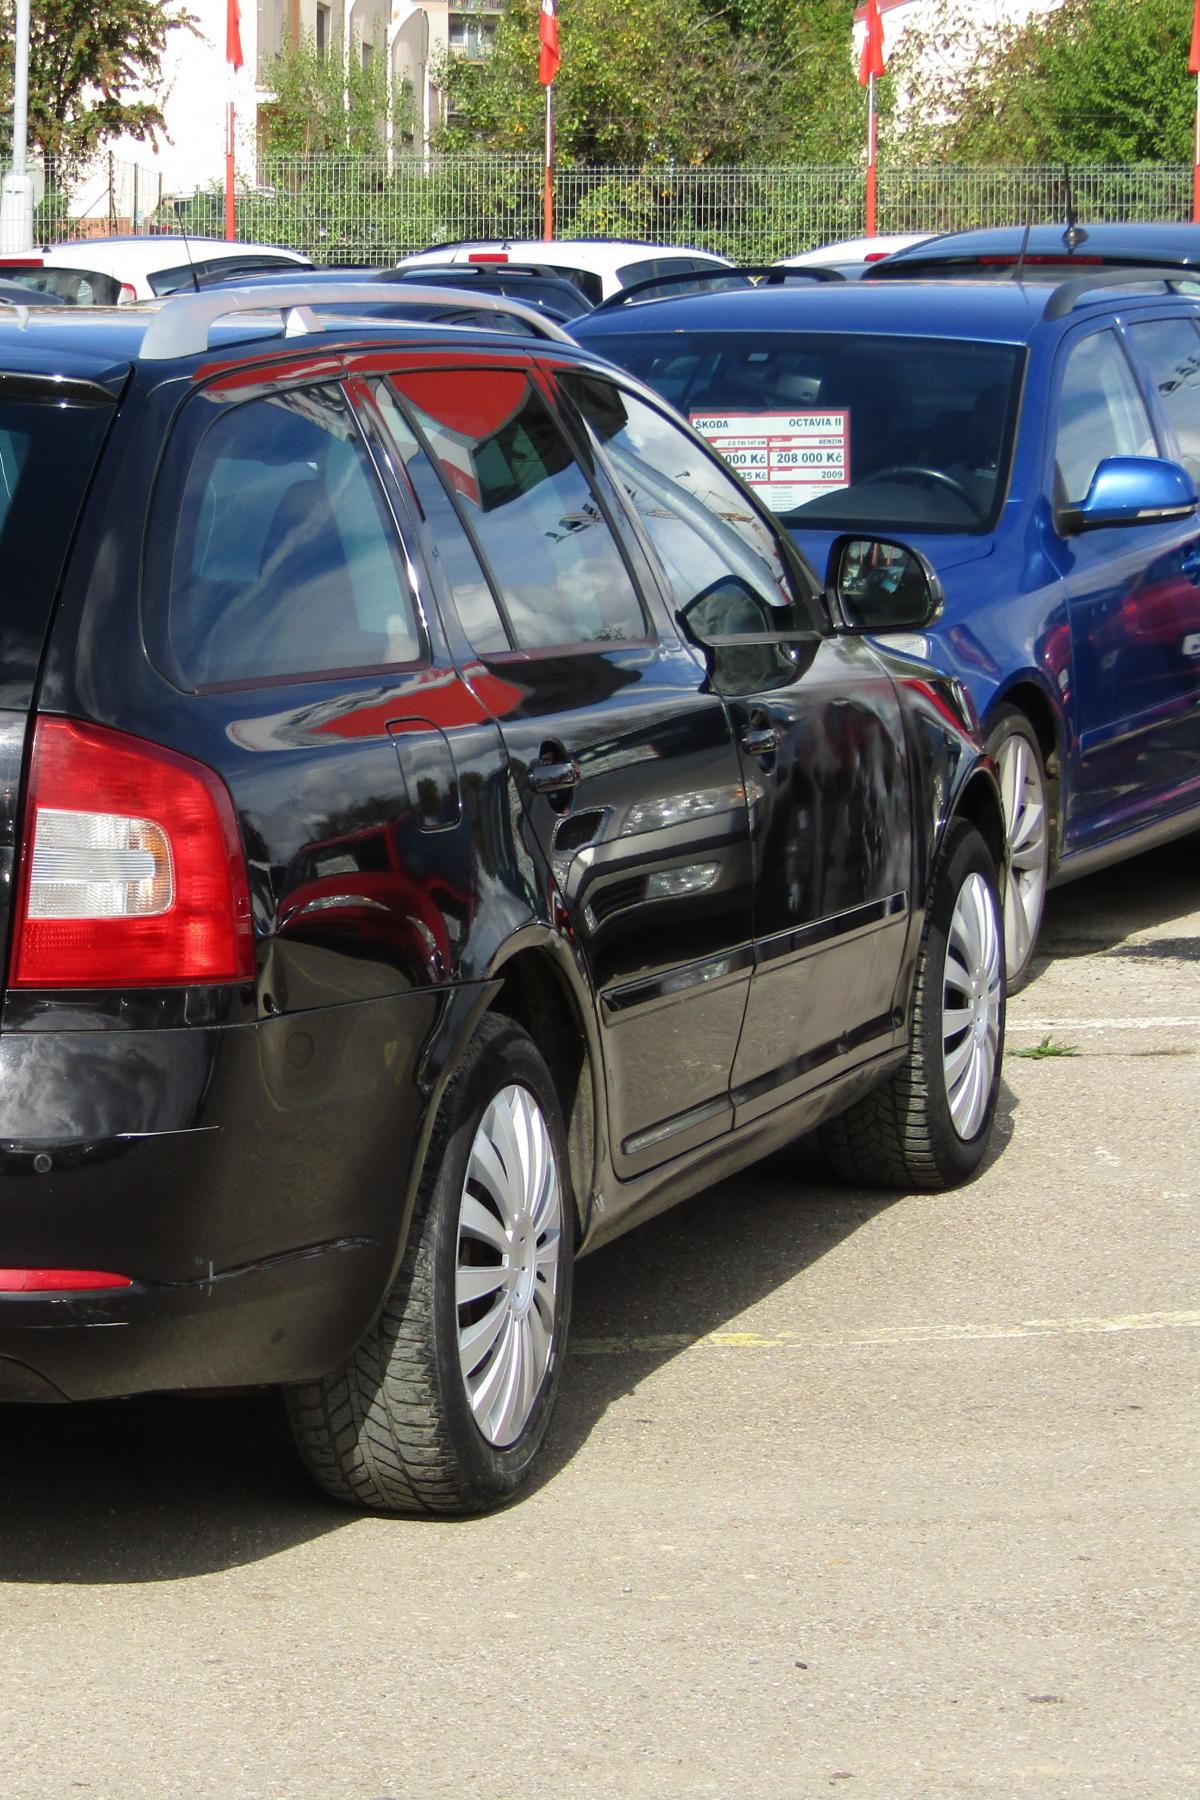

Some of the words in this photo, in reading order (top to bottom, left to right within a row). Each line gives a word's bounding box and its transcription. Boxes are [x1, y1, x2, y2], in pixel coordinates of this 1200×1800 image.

[695, 420, 728, 429] ŠKODA
[789, 418, 831, 427] OCTAVIA
[834, 417, 841, 426] II
[725, 453, 746, 464] 000
[750, 453, 766, 463] Kč
[777, 453, 798, 463] 208
[801, 453, 823, 463] 000
[826, 452, 842, 463] Kč
[755, 472, 767, 480] Kč
